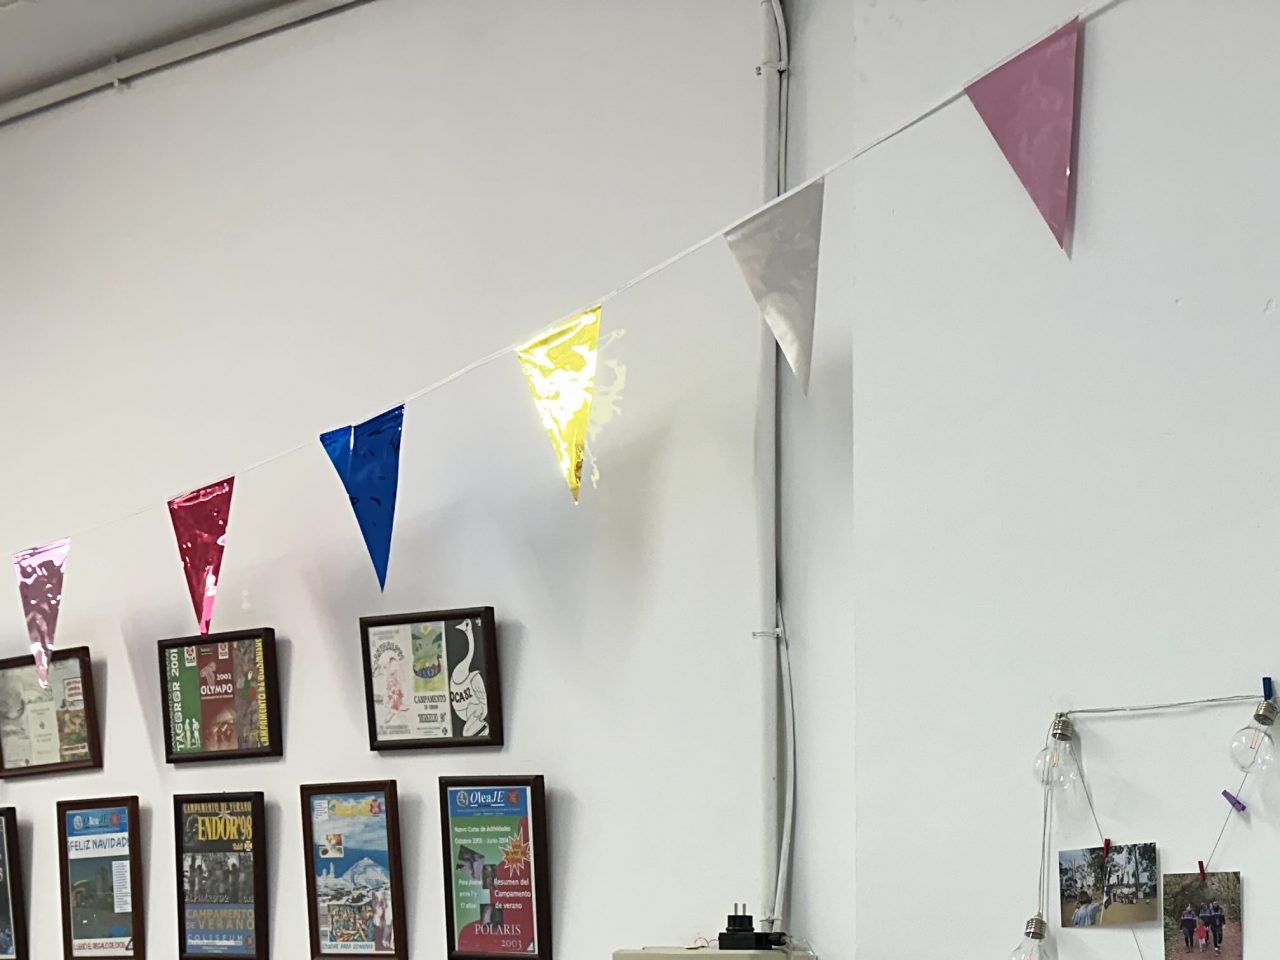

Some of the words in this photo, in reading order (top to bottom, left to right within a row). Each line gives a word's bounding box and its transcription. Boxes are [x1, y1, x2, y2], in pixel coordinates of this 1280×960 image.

[170, 649, 180, 677] 2001
[200, 683, 233, 695] OLYMPO
[413, 695, 447, 704] CAMPAMENTO
[173, 681, 185, 752] TAGOROR
[258, 693, 270, 746] CAMPAMENTO
[470, 790, 505, 804] OleaJE
[183, 803, 218, 814] CAMPAMENTO
[198, 815, 252, 841] ENDOR'98
[494, 877, 519, 887] Resumen
[520, 878, 529, 886] del
[494, 889, 532, 898] Campamento
[495, 901, 502, 909] de
[186, 909, 255, 919] CAMPAMENTO
[198, 919, 255, 931] VERANO
[475, 923, 522, 935] POLARIS
[187, 933, 244, 942] COLISEUM
[501, 940, 522, 949] 2003
